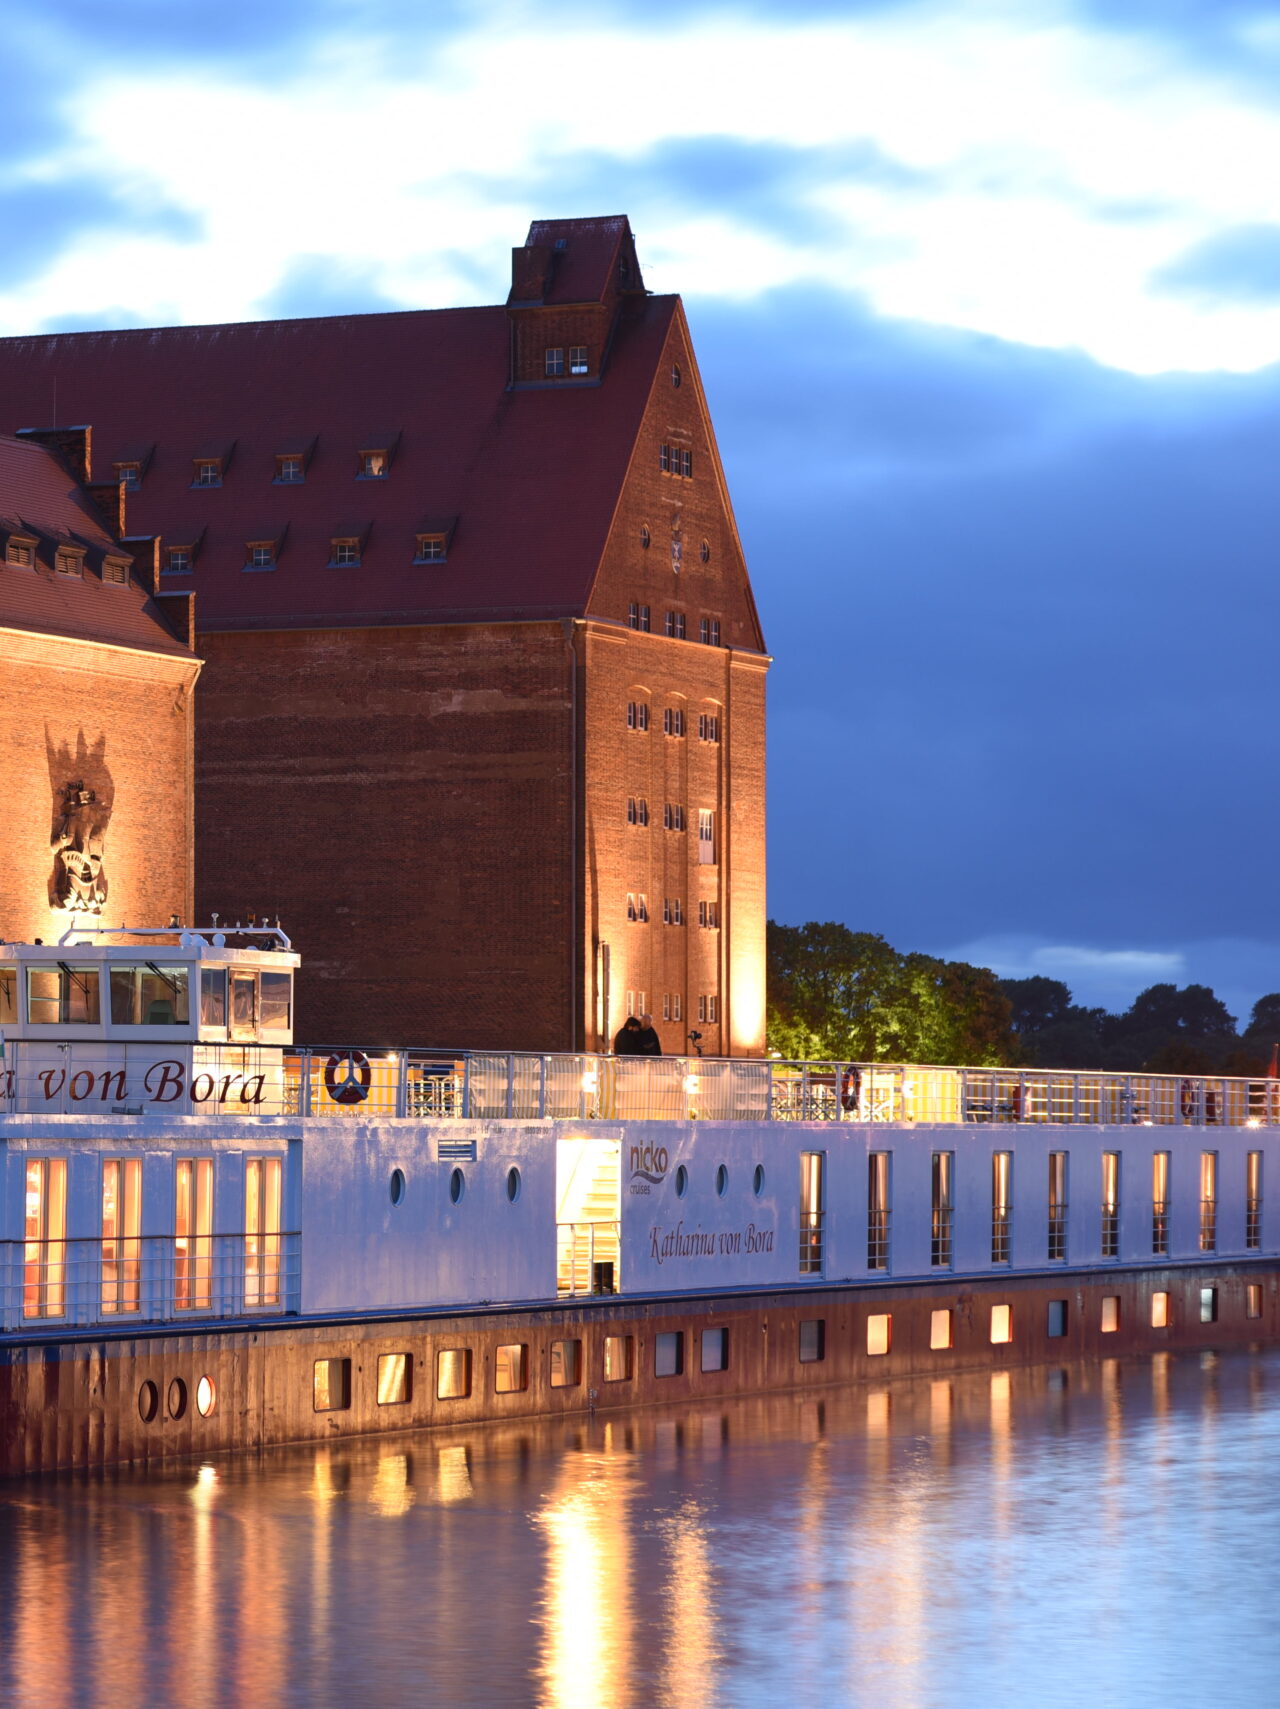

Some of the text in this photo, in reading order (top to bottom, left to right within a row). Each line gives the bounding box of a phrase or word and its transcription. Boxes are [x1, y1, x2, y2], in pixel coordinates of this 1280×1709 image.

[38, 1068, 128, 1101] von
[144, 1060, 267, 1104] Bora
[630, 1140, 668, 1173] nicko
[629, 1184, 651, 1195] cruises
[649, 1220, 775, 1265] Katharina von Bora
